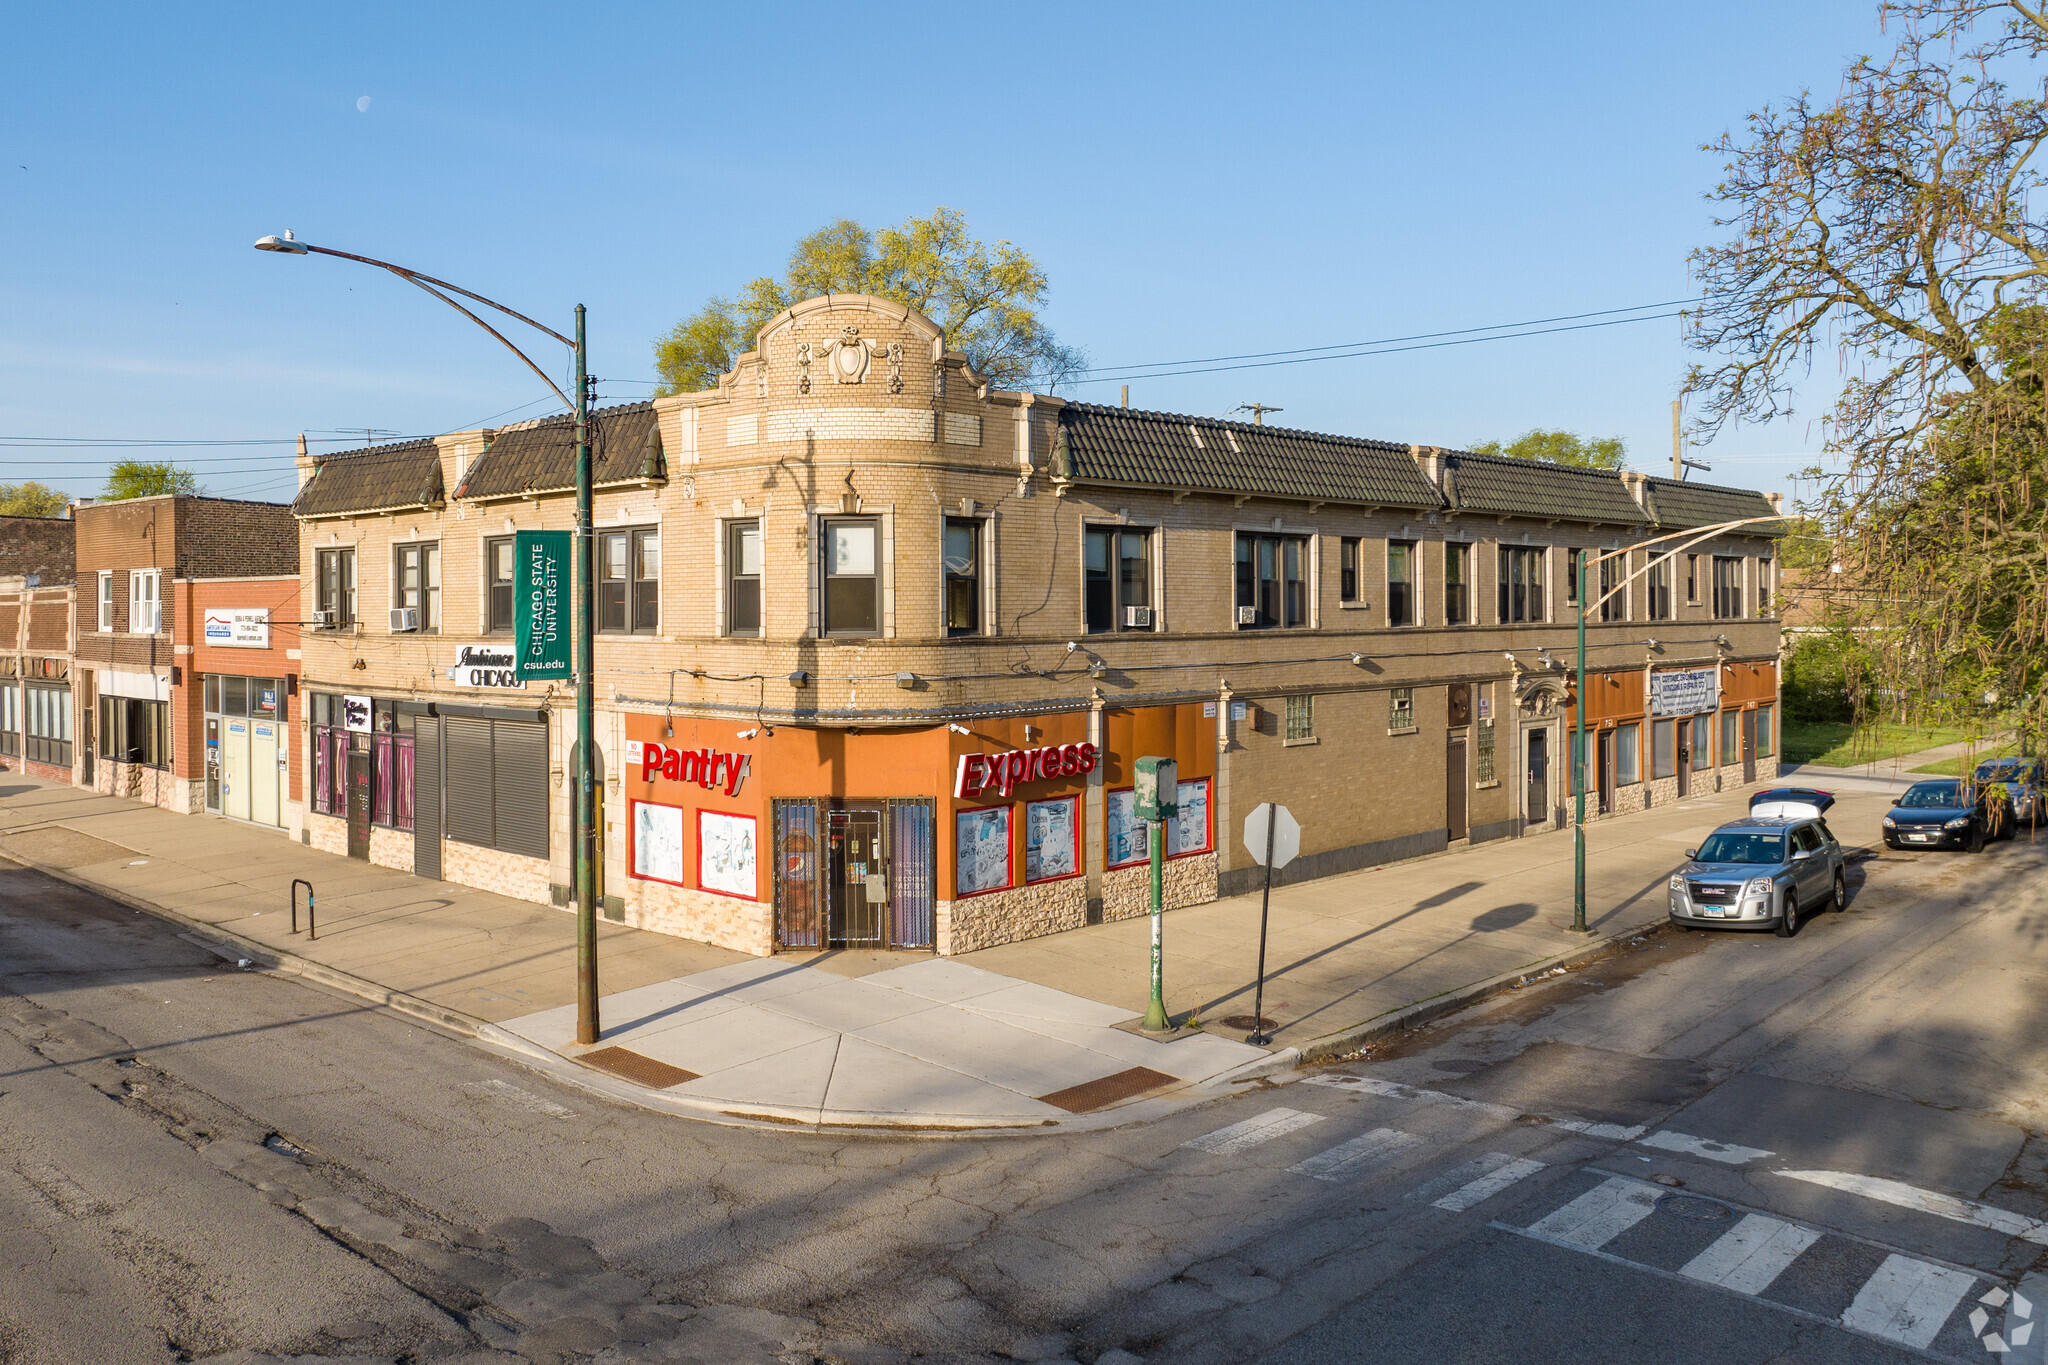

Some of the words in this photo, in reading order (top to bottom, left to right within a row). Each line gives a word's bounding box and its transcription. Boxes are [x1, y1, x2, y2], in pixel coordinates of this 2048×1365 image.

[532, 544, 543, 586] STATE
[546, 556, 557, 642] UNIVERSITY
[532, 590, 543, 656] CHICAGO
[455, 646, 514, 668] Ambiance
[523, 659, 565, 670] csu.edu
[470, 669, 521, 688] CHICAGO
[643, 742, 746, 796] Pantry
[957, 742, 1096, 798] Express
[1702, 887, 1726, 895] GMC
